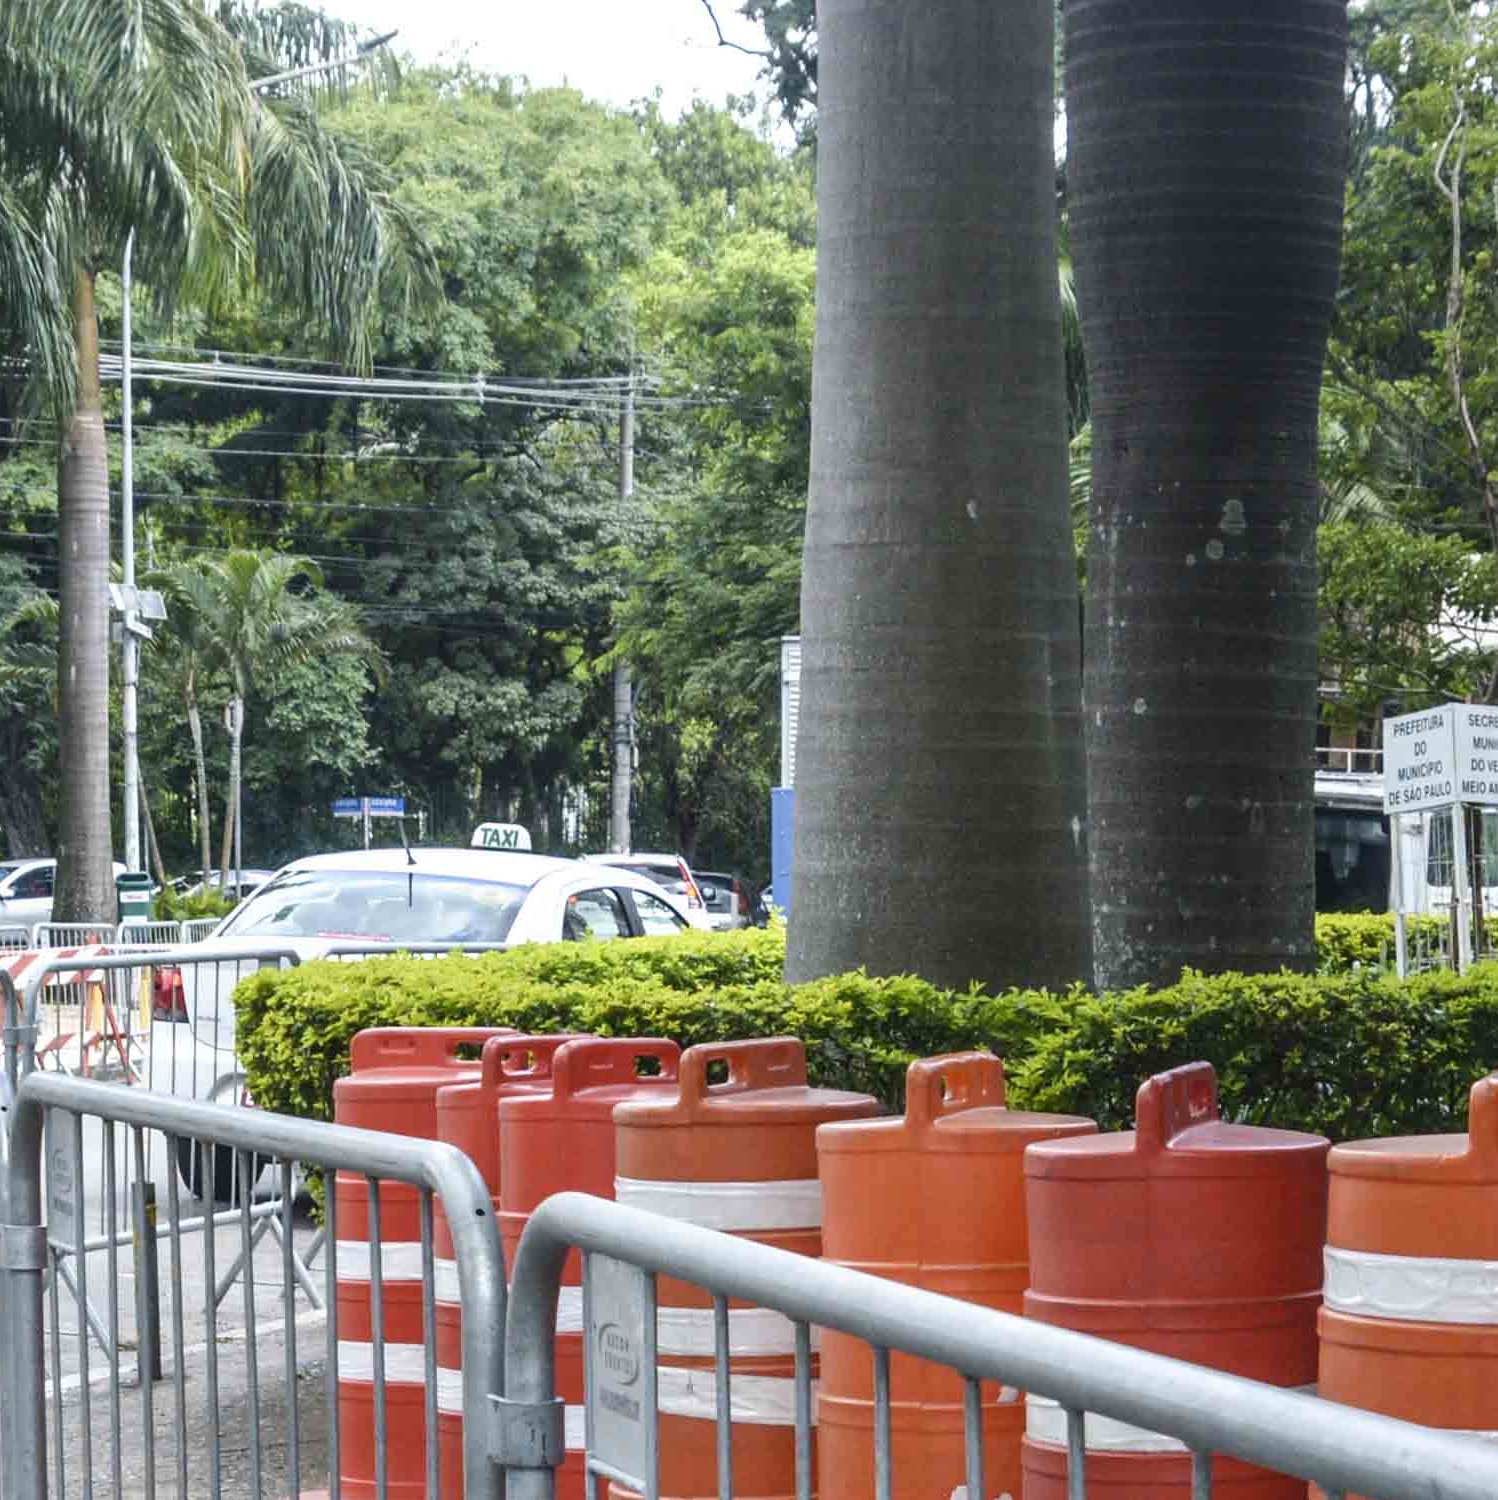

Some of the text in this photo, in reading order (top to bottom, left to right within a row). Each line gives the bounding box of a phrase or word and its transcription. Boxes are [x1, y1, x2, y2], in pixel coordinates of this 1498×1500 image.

[1393, 714, 1444, 736] PREFEITURA
[1414, 741, 1427, 756] DO
[1470, 758, 1487, 773] DO
[1388, 791, 1402, 806] DE
[1424, 781, 1452, 799] PAULO
[1462, 780, 1487, 795] MEIO
[480, 828, 519, 849] TAXI
